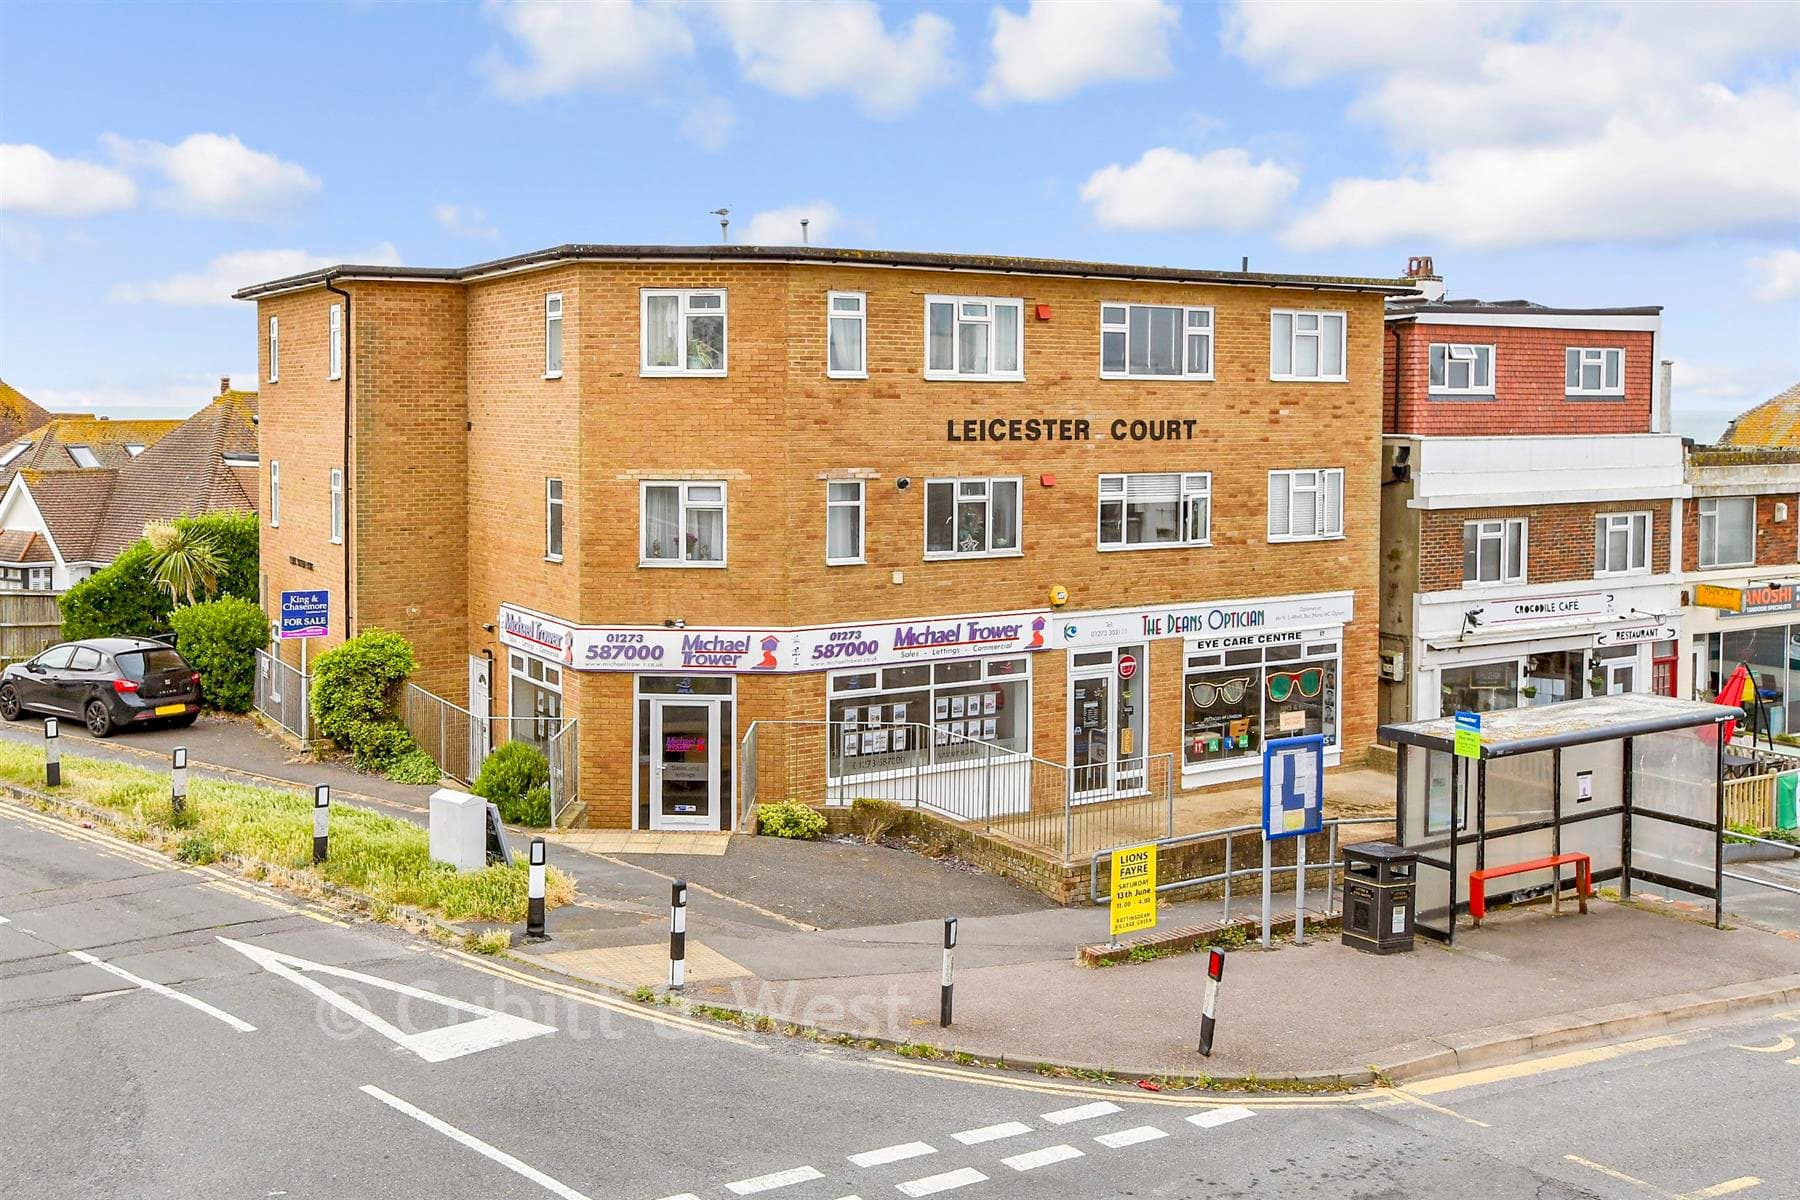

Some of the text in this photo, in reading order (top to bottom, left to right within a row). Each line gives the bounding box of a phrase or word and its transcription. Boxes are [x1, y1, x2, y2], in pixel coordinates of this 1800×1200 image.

[947, 419, 1197, 442] LEICESTER COURT
[290, 595, 319, 605] King &
[1746, 586, 1793, 606] ANOSHI
[283, 603, 328, 611] Chasemore
[1514, 599, 1580, 614] CROCODILE CAFÉ
[284, 617, 327, 626] FOR SALE
[1142, 615, 1162, 636] THE
[1167, 613, 1203, 634] DEANS
[1208, 609, 1266, 630] OPTICIAN
[606, 633, 644, 643] 01273
[829, 630, 862, 642] 01273
[893, 621, 1024, 648] Michael Trower
[1197, 631, 1303, 650] EYE CARE CENTRE
[1616, 629, 1659, 641] RESTAURANT
[681, 634, 751, 652] Michael
[585, 645, 665, 661] 587000
[811, 641, 879, 660] 587000
[900, 643, 1013, 659] Sales Lettings Commercial
[584, 660, 664, 668] www.michaeltrowr.co.uk
[681, 651, 742, 665] Trower
[1120, 851, 1149, 864] LIONS
[1120, 864, 1148, 877] FAYRE
[1118, 879, 1149, 890] SATURDAY
[1117, 887, 1151, 900] 13th June
